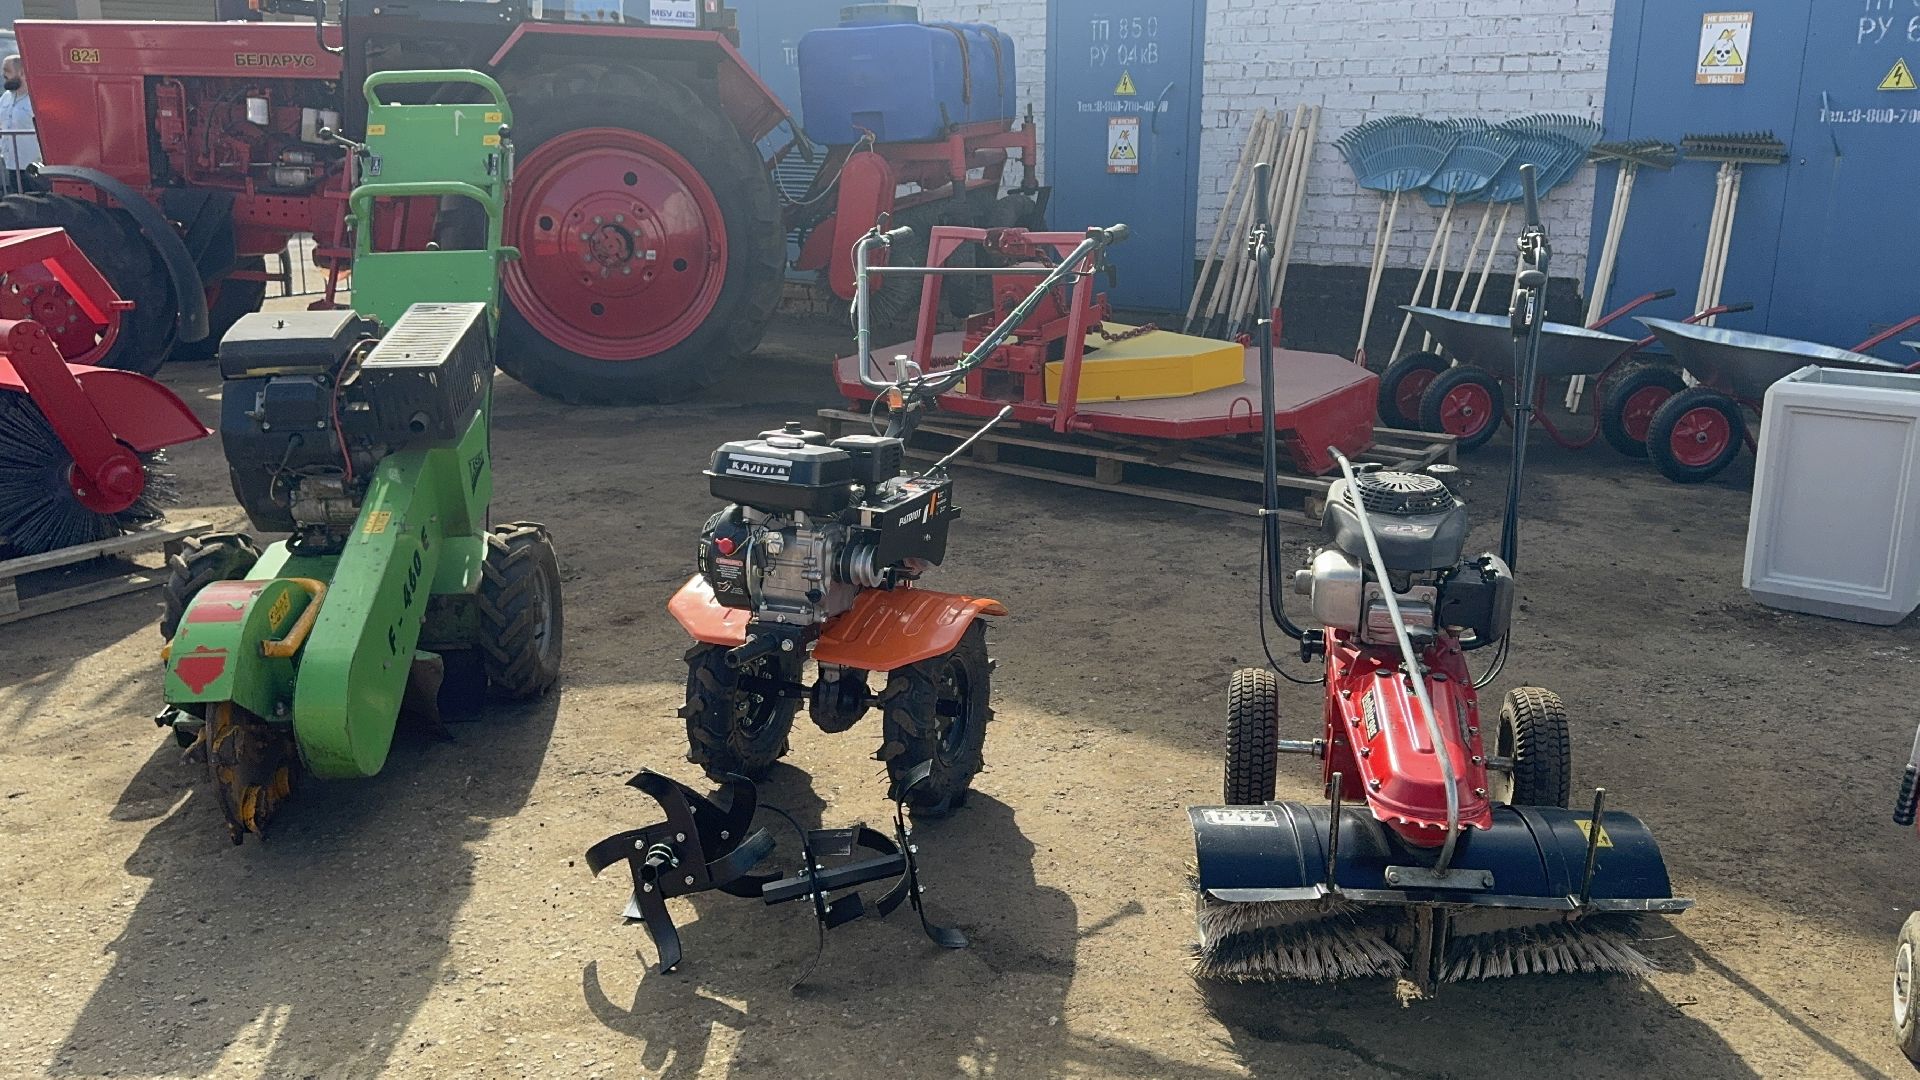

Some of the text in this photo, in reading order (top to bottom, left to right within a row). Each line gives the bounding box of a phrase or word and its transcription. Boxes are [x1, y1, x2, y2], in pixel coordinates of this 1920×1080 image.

[651, 9, 695, 19] МБУ ДЕЗ
[1090, 19, 1110, 41] ТП
[1858, 16, 1894, 44] РУ
[234, 52, 316, 67] БЕЛАРУС
[1090, 46, 1109, 67] РУ
[898, 508, 922, 527] PATRIOT
